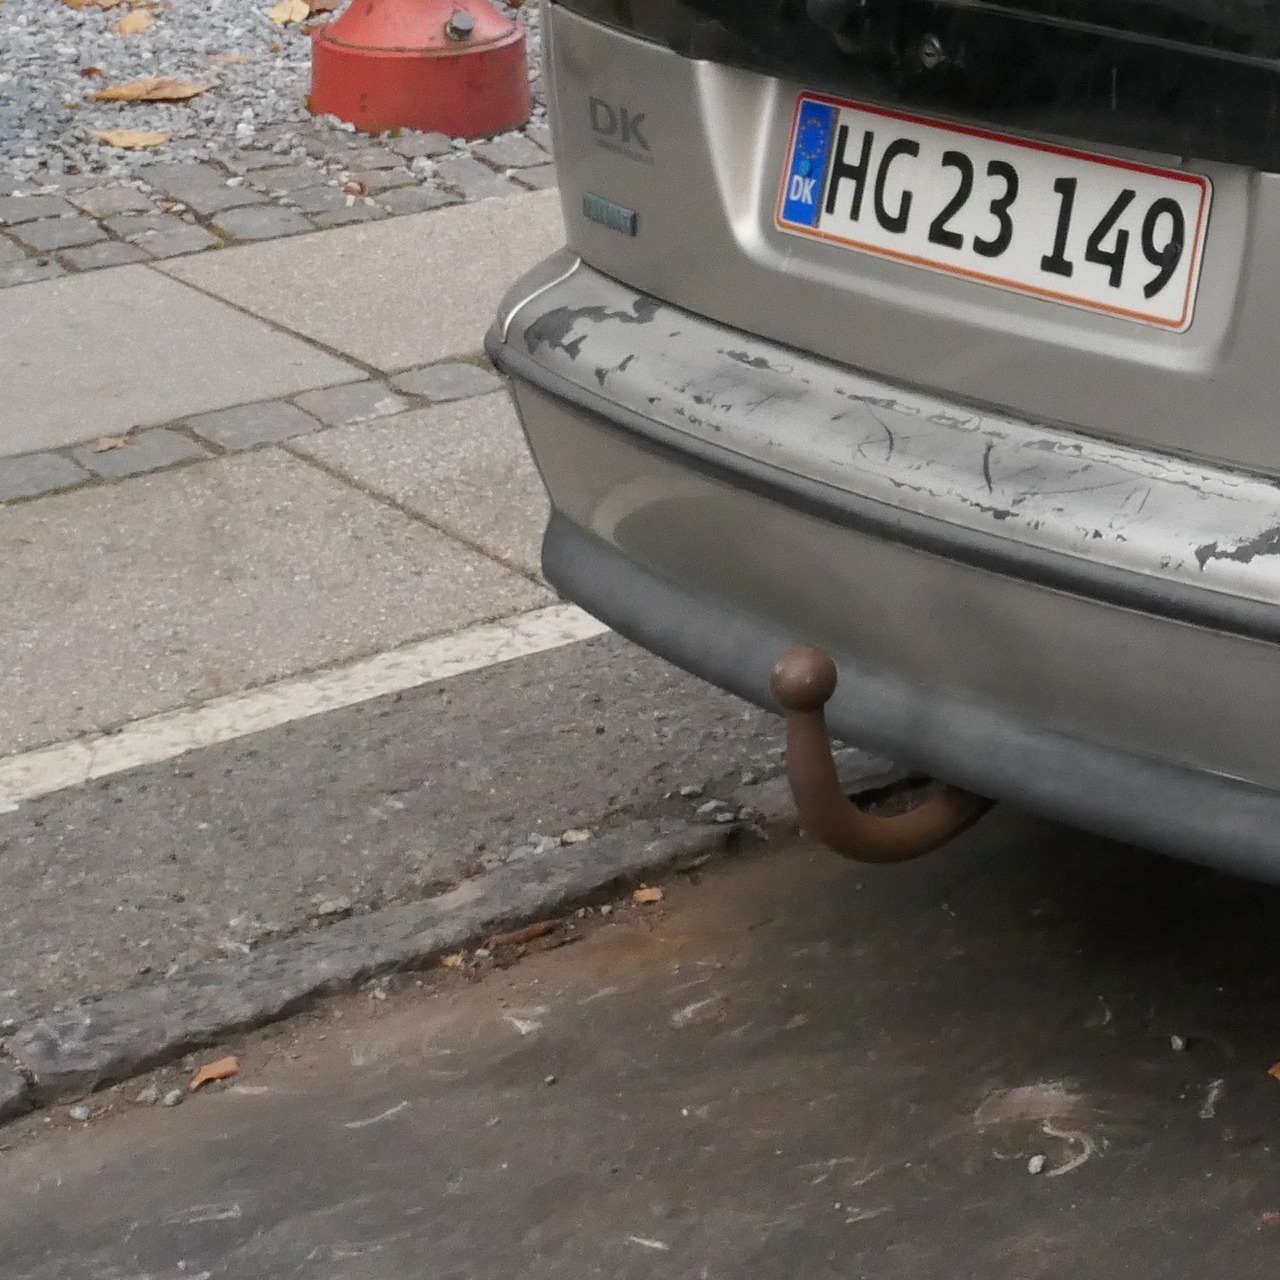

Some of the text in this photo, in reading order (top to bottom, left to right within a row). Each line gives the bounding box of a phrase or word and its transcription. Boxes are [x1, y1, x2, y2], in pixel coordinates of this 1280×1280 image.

[590, 96, 651, 151] DK
[790, 174, 816, 204] DK
[825, 124, 1186, 299] HG 23 149
